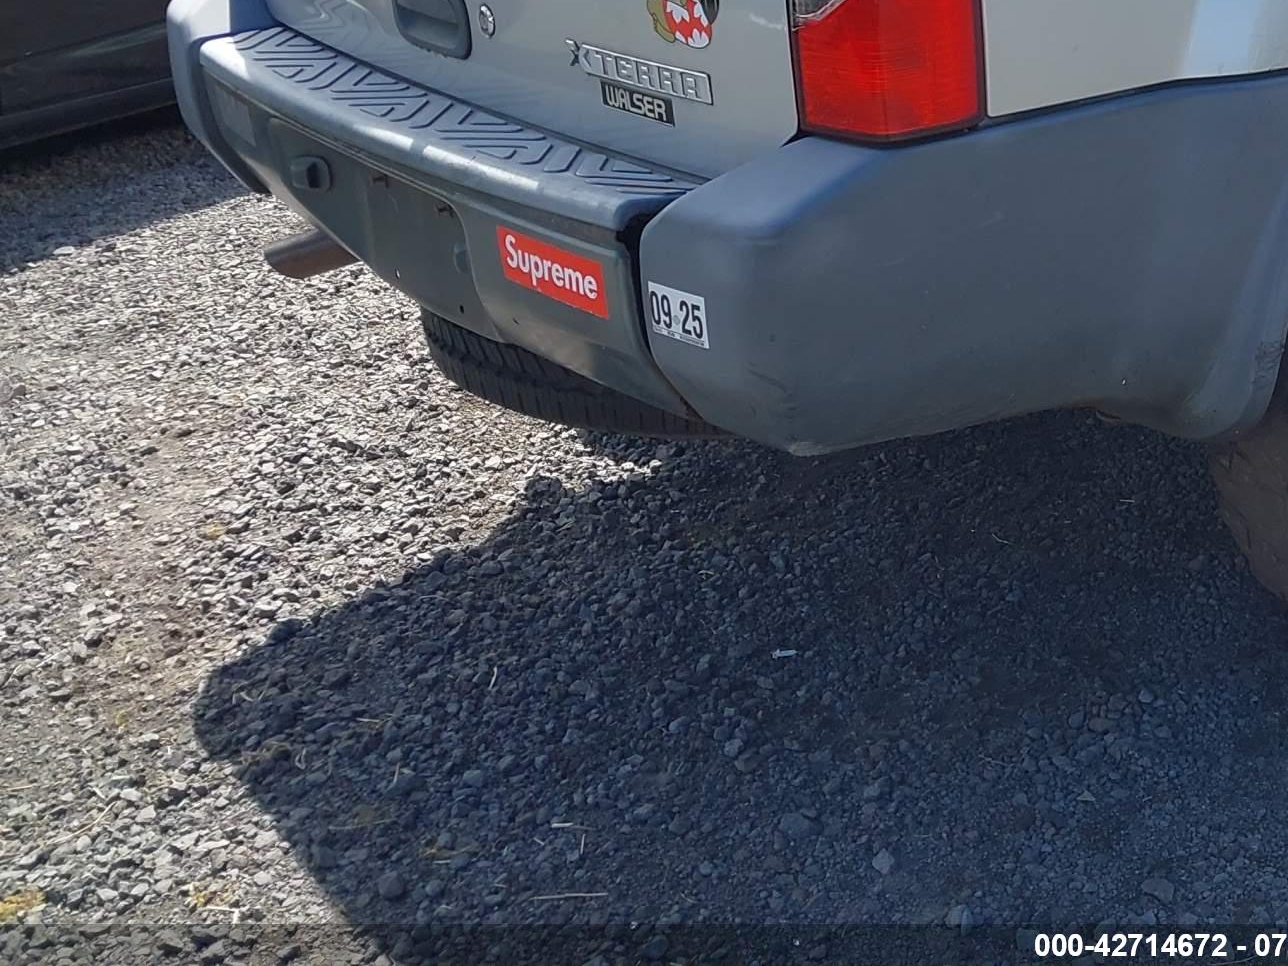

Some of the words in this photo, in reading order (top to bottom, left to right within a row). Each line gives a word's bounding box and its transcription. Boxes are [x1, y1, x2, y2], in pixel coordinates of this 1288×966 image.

[565, 38, 704, 101] XTERRA
[604, 84, 667, 122] WALSER
[504, 234, 599, 300] Supreme
[650, 290, 673, 330] 09
[679, 299, 704, 340] 25
